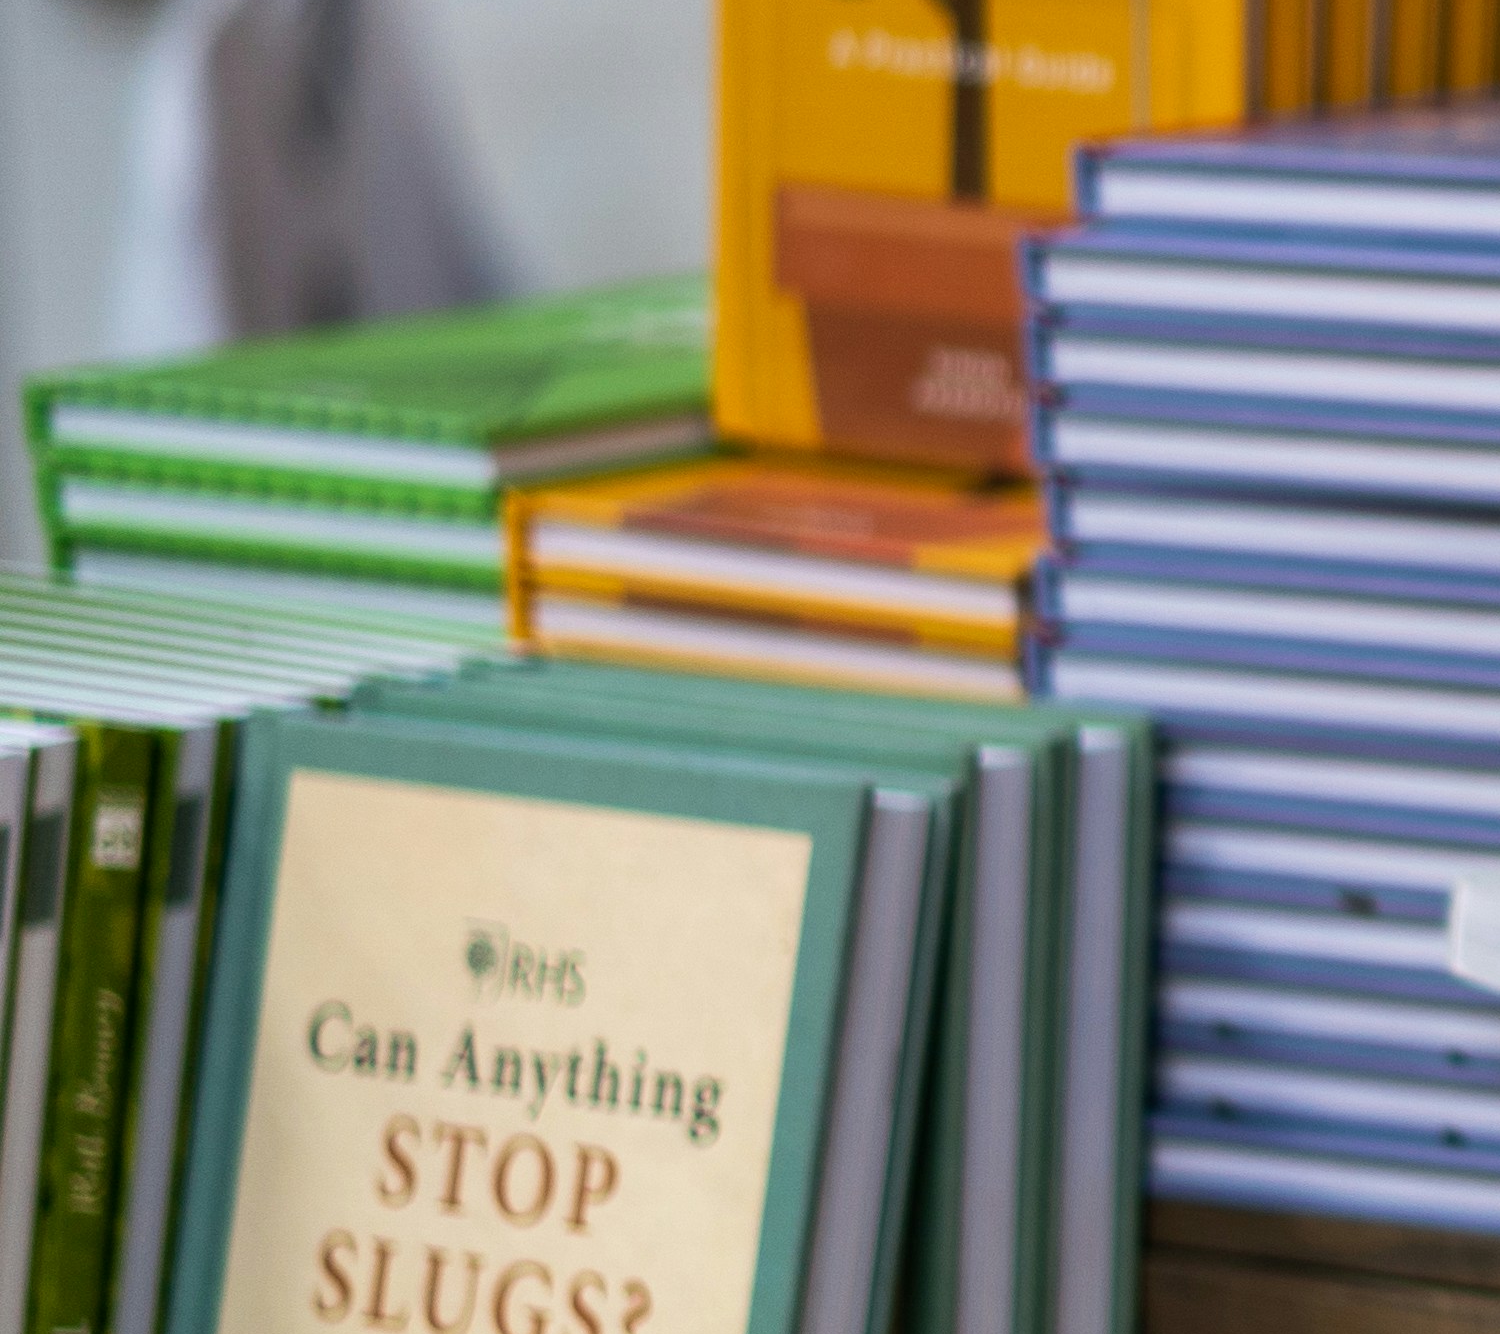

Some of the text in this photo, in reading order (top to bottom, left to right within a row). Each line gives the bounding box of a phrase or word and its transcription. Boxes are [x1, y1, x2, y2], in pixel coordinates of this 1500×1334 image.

[505, 941, 588, 1007] RHS
[306, 998, 725, 1150] Can Anything
[373, 1111, 622, 1237] STOP
